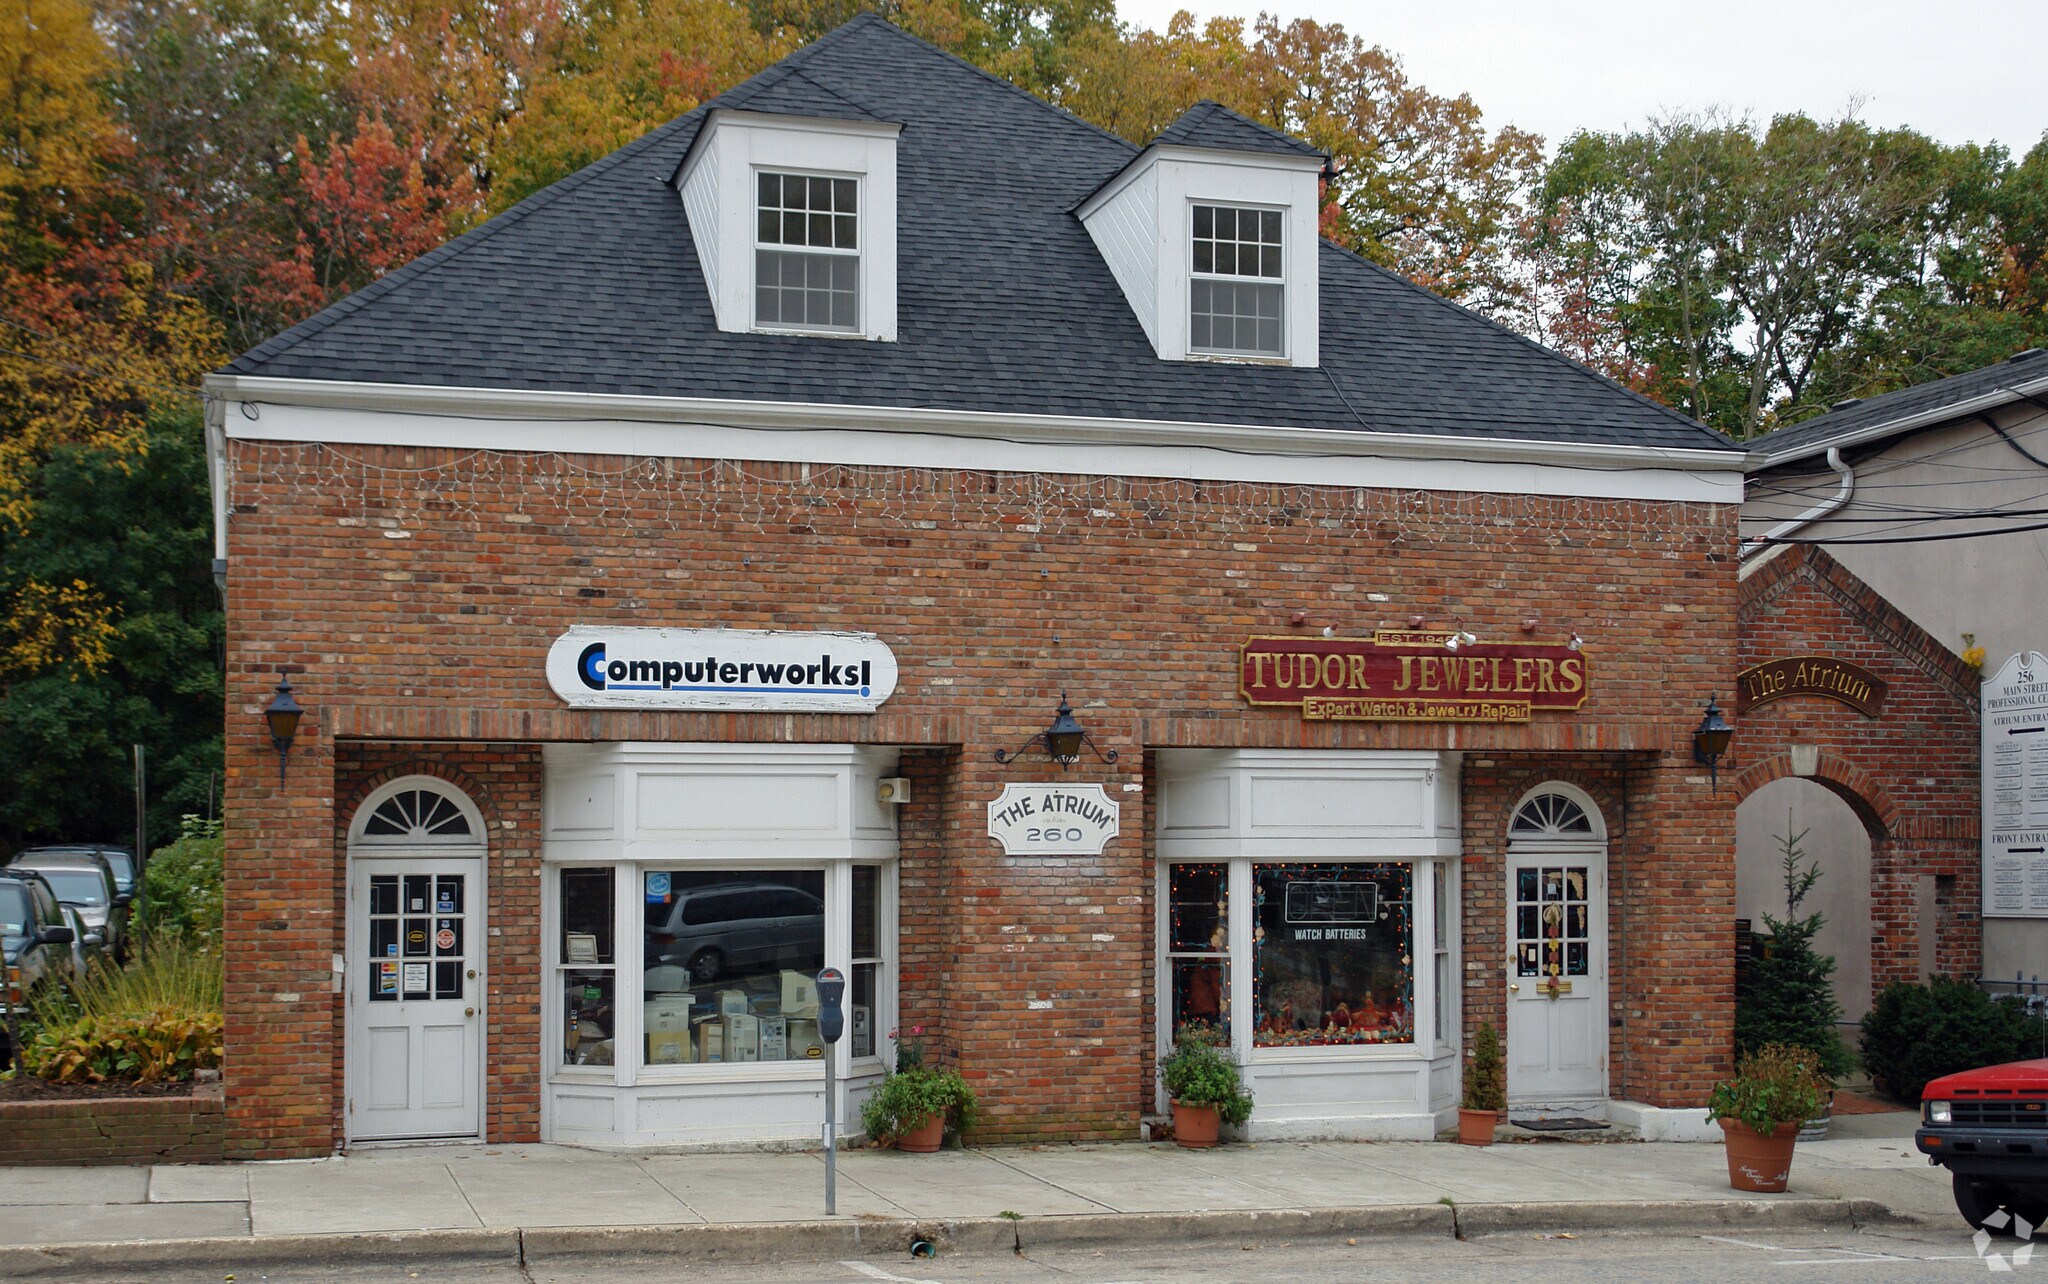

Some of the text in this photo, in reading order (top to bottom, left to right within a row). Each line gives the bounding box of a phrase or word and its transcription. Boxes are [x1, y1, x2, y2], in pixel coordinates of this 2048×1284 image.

[578, 642, 871, 697] Computerworks!
[1246, 652, 1583, 693] TUDOR JEWELERS
[1744, 661, 1871, 702] The Atrium
[2017, 671, 2034, 683] 256
[2003, 682, 2048, 696] MAIN STREET
[1986, 695, 2036, 709] PROFESSIONAL
[1307, 701, 1356, 718] Expert
[1360, 702, 1405, 716] Watch
[1407, 702, 1418, 716] &
[1481, 703, 1527, 720] Repair
[1993, 715, 2020, 726] ATRIUM
[997, 794, 1111, 829] THE ATRIUM
[1027, 828, 1083, 842] 260
[1992, 833, 2048, 844] FRONT ENTRA
[1295, 929, 1366, 940] WATCH BATTERIES
